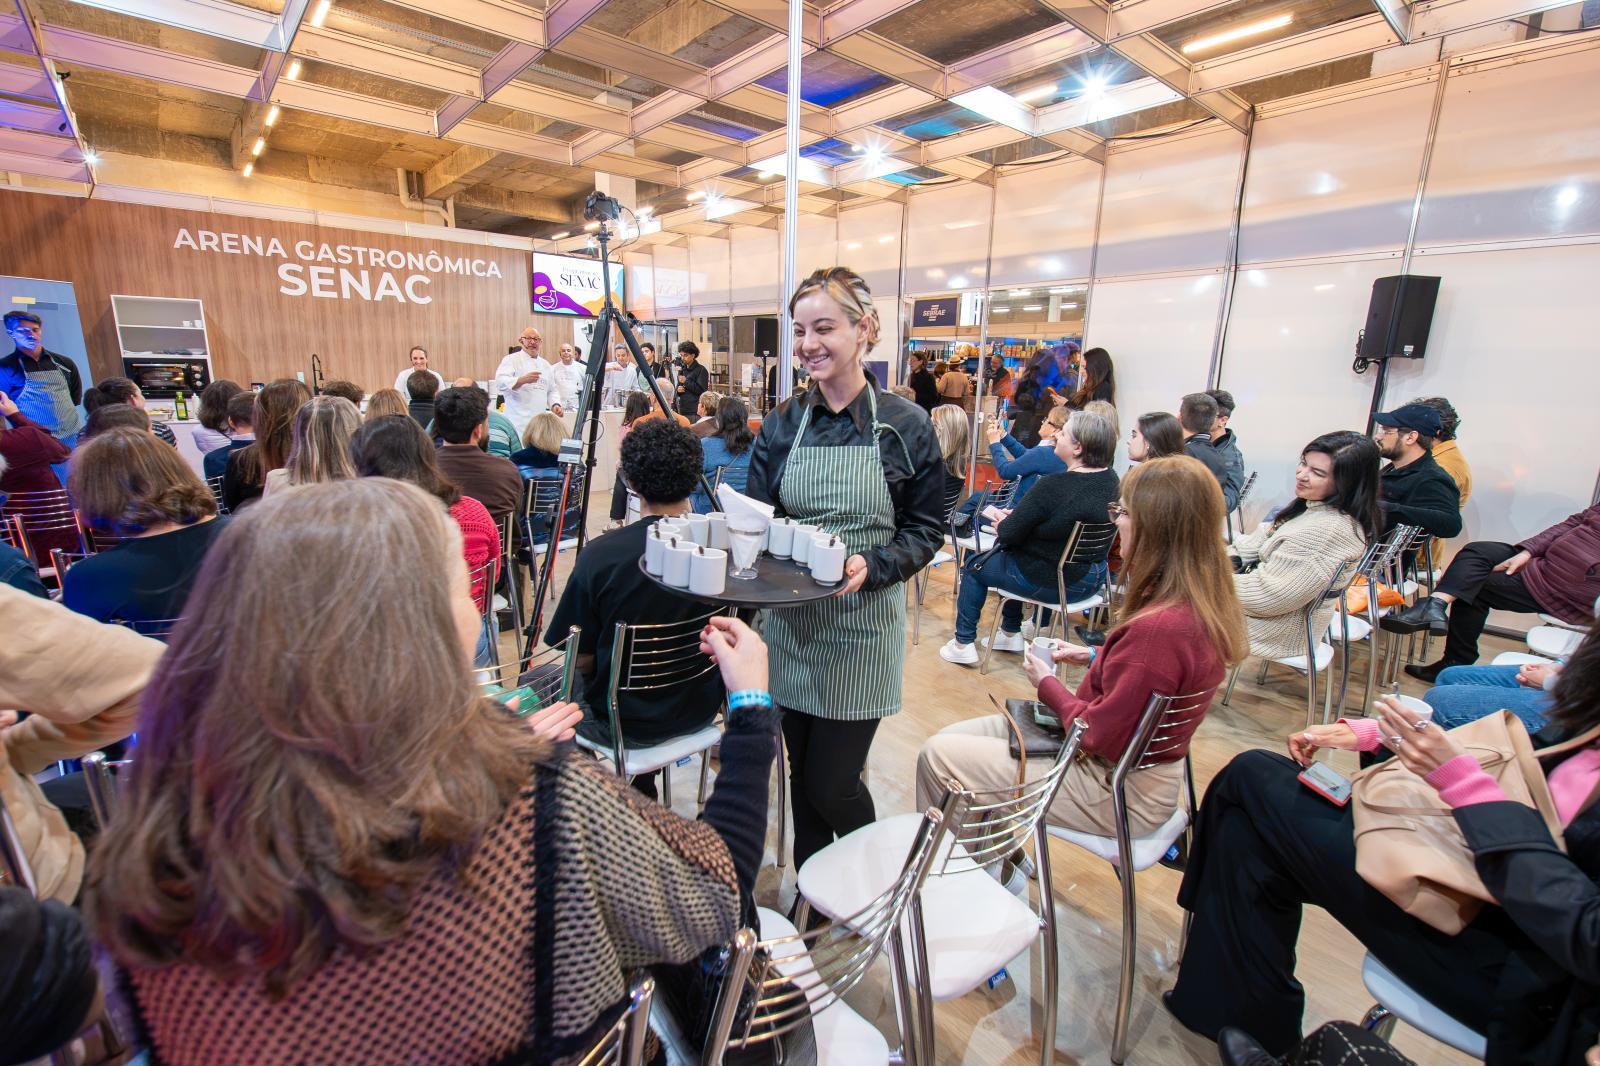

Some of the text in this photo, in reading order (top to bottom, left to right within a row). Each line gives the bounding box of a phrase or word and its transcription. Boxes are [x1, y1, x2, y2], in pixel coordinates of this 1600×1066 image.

[173, 228, 502, 279] ARENA GASTRONÔMICA
[277, 263, 433, 304] SENAC
[560, 273, 601, 290] SENAC
